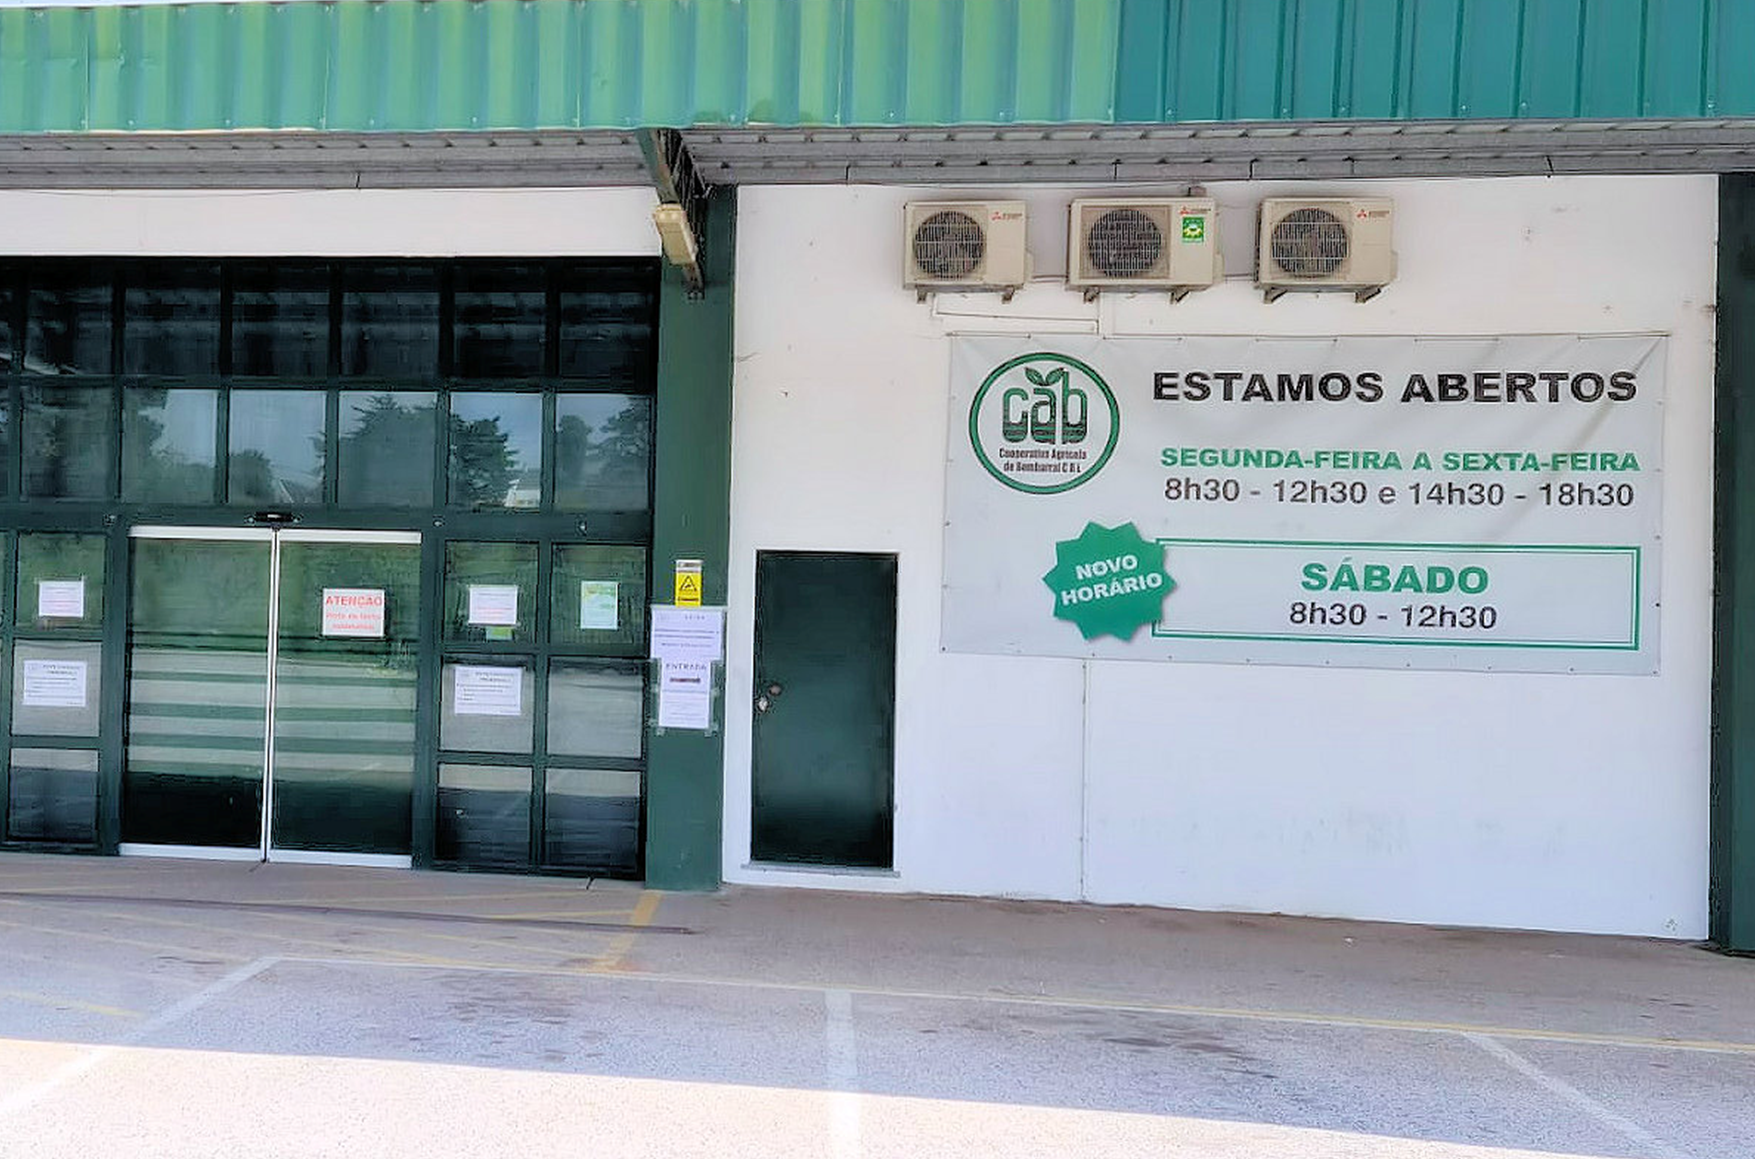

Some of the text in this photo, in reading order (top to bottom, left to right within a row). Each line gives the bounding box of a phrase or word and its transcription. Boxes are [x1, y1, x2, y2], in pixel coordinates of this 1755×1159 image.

[1153, 371, 1637, 404] ESTAMOS ABERTOS
[1003, 461, 1014, 472] de
[1161, 447, 1641, 472] SEGUNDA-FEIRA A SEXTA-FEIRA
[1165, 477, 1241, 502] 8h30
[1273, 479, 1368, 505] 12h30
[1378, 486, 1397, 505] e
[1409, 481, 1505, 507] 14h30
[1539, 482, 1635, 508] 18h30
[1075, 554, 1138, 580] NOVO
[1301, 557, 1489, 594] SÁBADO
[1061, 572, 1162, 606] HORÁRIO
[1289, 601, 1367, 626] 8h30
[1401, 604, 1498, 630] 12h30
